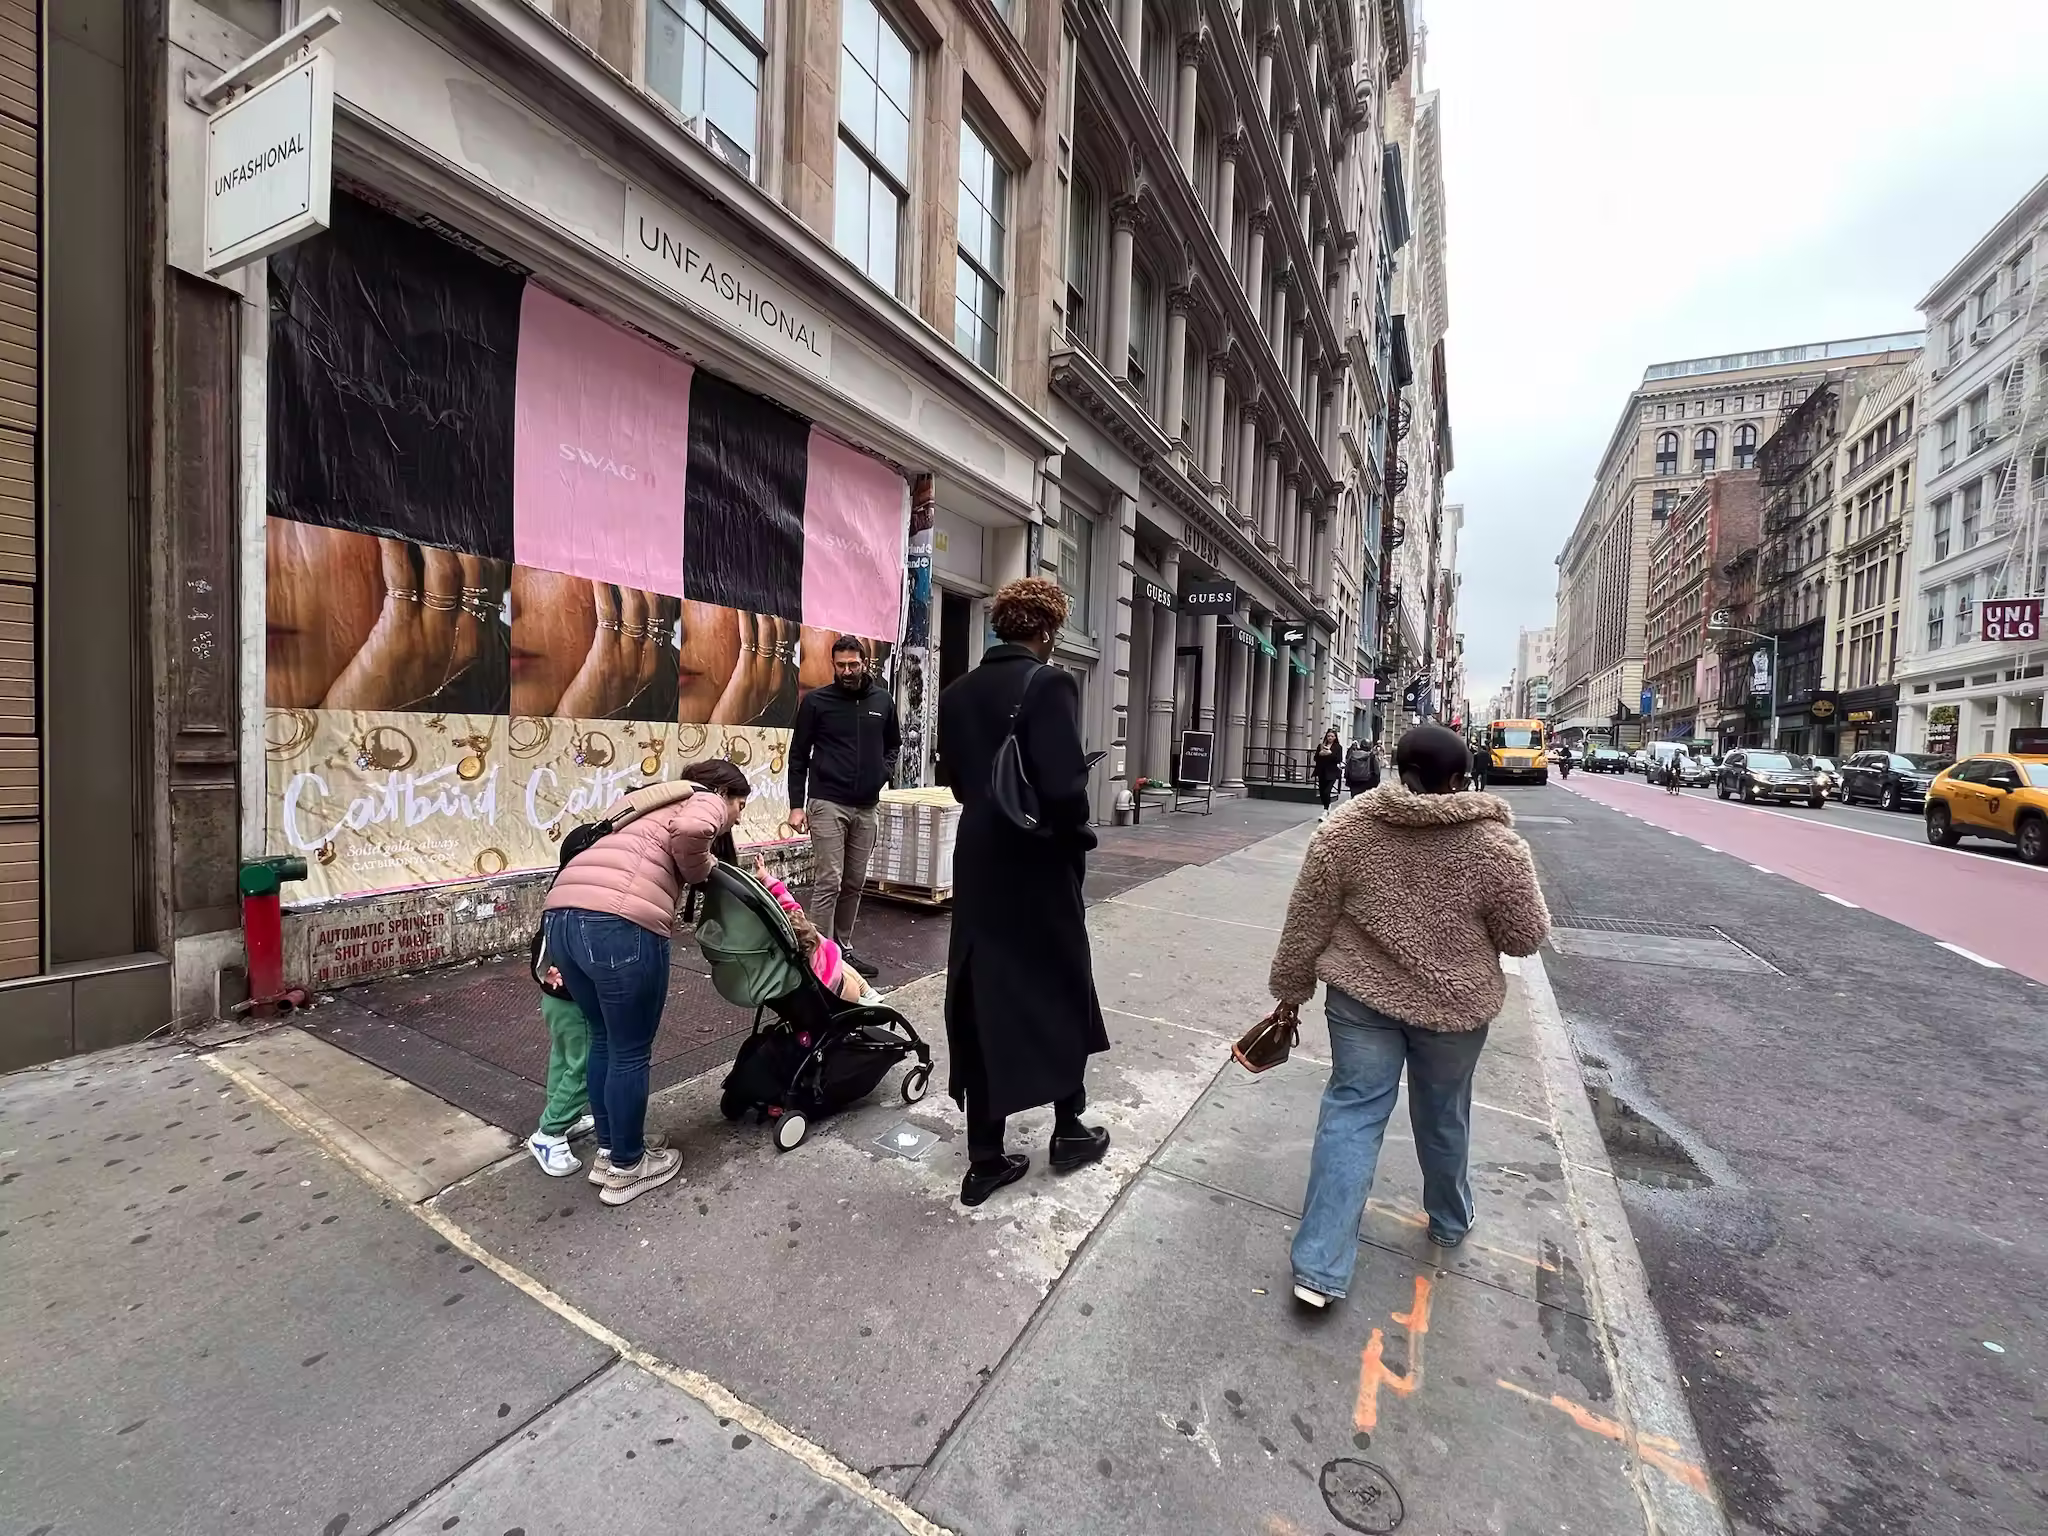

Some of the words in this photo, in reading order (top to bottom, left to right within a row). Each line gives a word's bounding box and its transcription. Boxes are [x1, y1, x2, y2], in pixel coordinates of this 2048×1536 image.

[215, 133, 304, 196] UNFASHIONAL
[639, 216, 822, 357] UNFASHIONAL
[559, 443, 637, 481] SWAG
[825, 534, 873, 557] SWAG
[1184, 523, 1220, 568] GUESS
[1146, 582, 1172, 607] GUESS
[1188, 592, 1232, 604] GUESS
[1986, 605, 2031, 622] UNI
[1238, 629, 1255, 646] GUESS
[1986, 622, 2034, 640] QLO
[283, 764, 503, 850] Catbird
[347, 842, 382, 857] Solid
[383, 839, 414, 857] gold,
[418, 838, 460, 851] always
[352, 853, 456, 872] CATBIRDNYC.COM
[319, 922, 385, 946] AUTOMATIC
[388, 912, 445, 934] SPRINKLER
[334, 941, 368, 961] SHUT
[371, 937, 394, 955] OFF
[333, 963, 358, 978] REAR
[376, 946, 446, 970] SUB-BASEMENT
